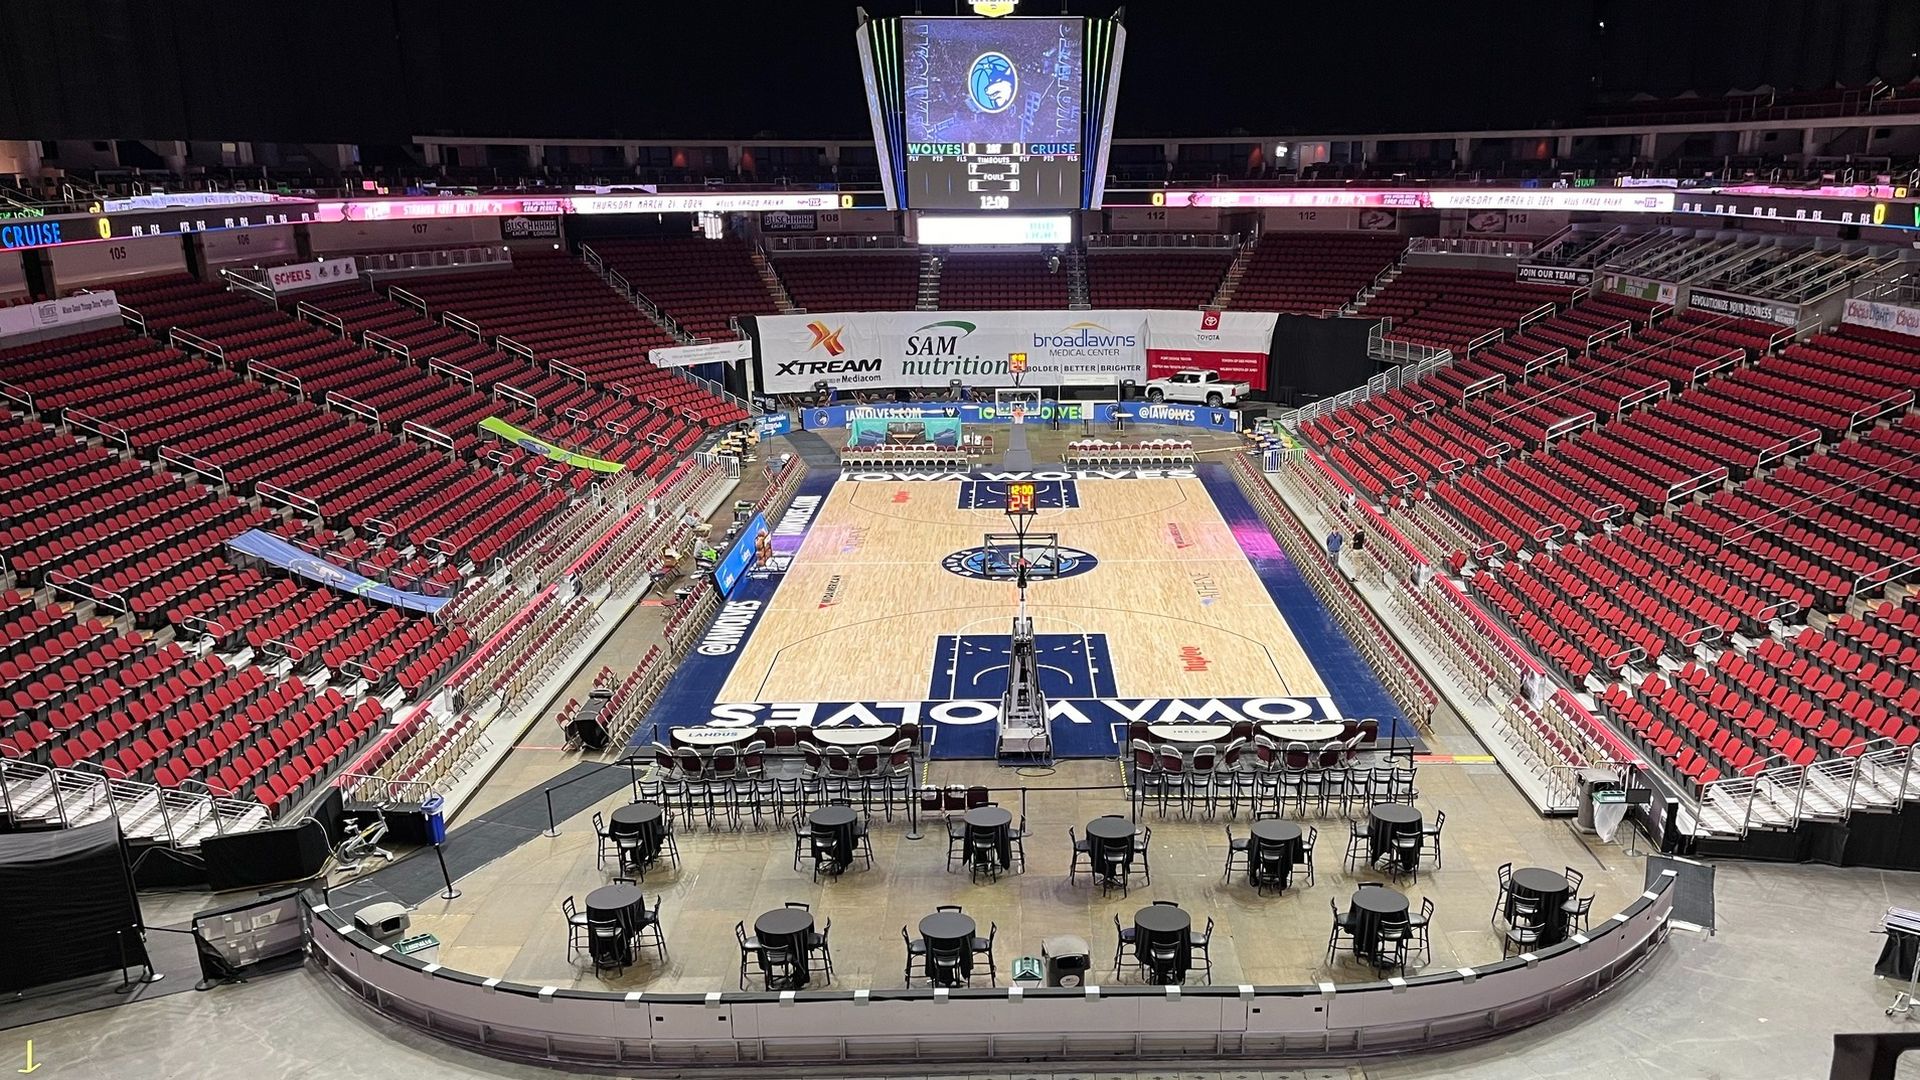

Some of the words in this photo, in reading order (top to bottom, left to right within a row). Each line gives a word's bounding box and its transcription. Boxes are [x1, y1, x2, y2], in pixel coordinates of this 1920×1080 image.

[907, 144, 962, 154] WOLVES
[1030, 145, 1076, 154] CRUISE
[592, 201, 633, 209] THURSDAY
[638, 200, 663, 209] MARCH
[683, 199, 703, 208] 2024
[1449, 196, 1493, 205] THURSDAY
[821, 213, 839, 222] 108
[1147, 211, 1165, 220] 112
[1298, 211, 1317, 221] 112
[1507, 213, 1528, 224] 113
[1873, 204, 1886, 225] 0
[1, 222, 62, 249] CRUISE
[98, 218, 111, 239] 0
[412, 223, 428, 235] 107
[110, 246, 127, 260] 105
[275, 271, 312, 286] SCHEELS
[1520, 268, 1536, 277] JOIN
[1537, 270, 1553, 279] OUR
[1554, 271, 1575, 280] TEAM
[1691, 294, 1729, 312] REVOLUTIONIZE
[1730, 301, 1744, 315] YOUR
[1745, 304, 1772, 319] BUSINESS
[1034, 328, 1136, 348] broadlawns
[905, 335, 958, 356] SAM
[1049, 348, 1086, 357] MEDICAL
[1087, 348, 1120, 356] CENTER
[775, 358, 882, 377] XTREAM
[902, 355, 1009, 376] nutrition
[1026, 365, 1059, 373] BOLDER
[1064, 364, 1096, 372] BETTER
[1100, 364, 1141, 372] BRIGHTER
[841, 374, 882, 384] Mediacom
[846, 406, 923, 421] IAWOLVES.COM
[1139, 405, 1196, 422] @IAWOLVES
[1213, 413, 1221, 424] W
[836, 471, 974, 482] IOWA
[980, 470, 1198, 481] WOLVES
[1011, 496, 1034, 511] 24
[697, 600, 762, 656] @IAWOLVES
[1100, 698, 1344, 722] IOWA
